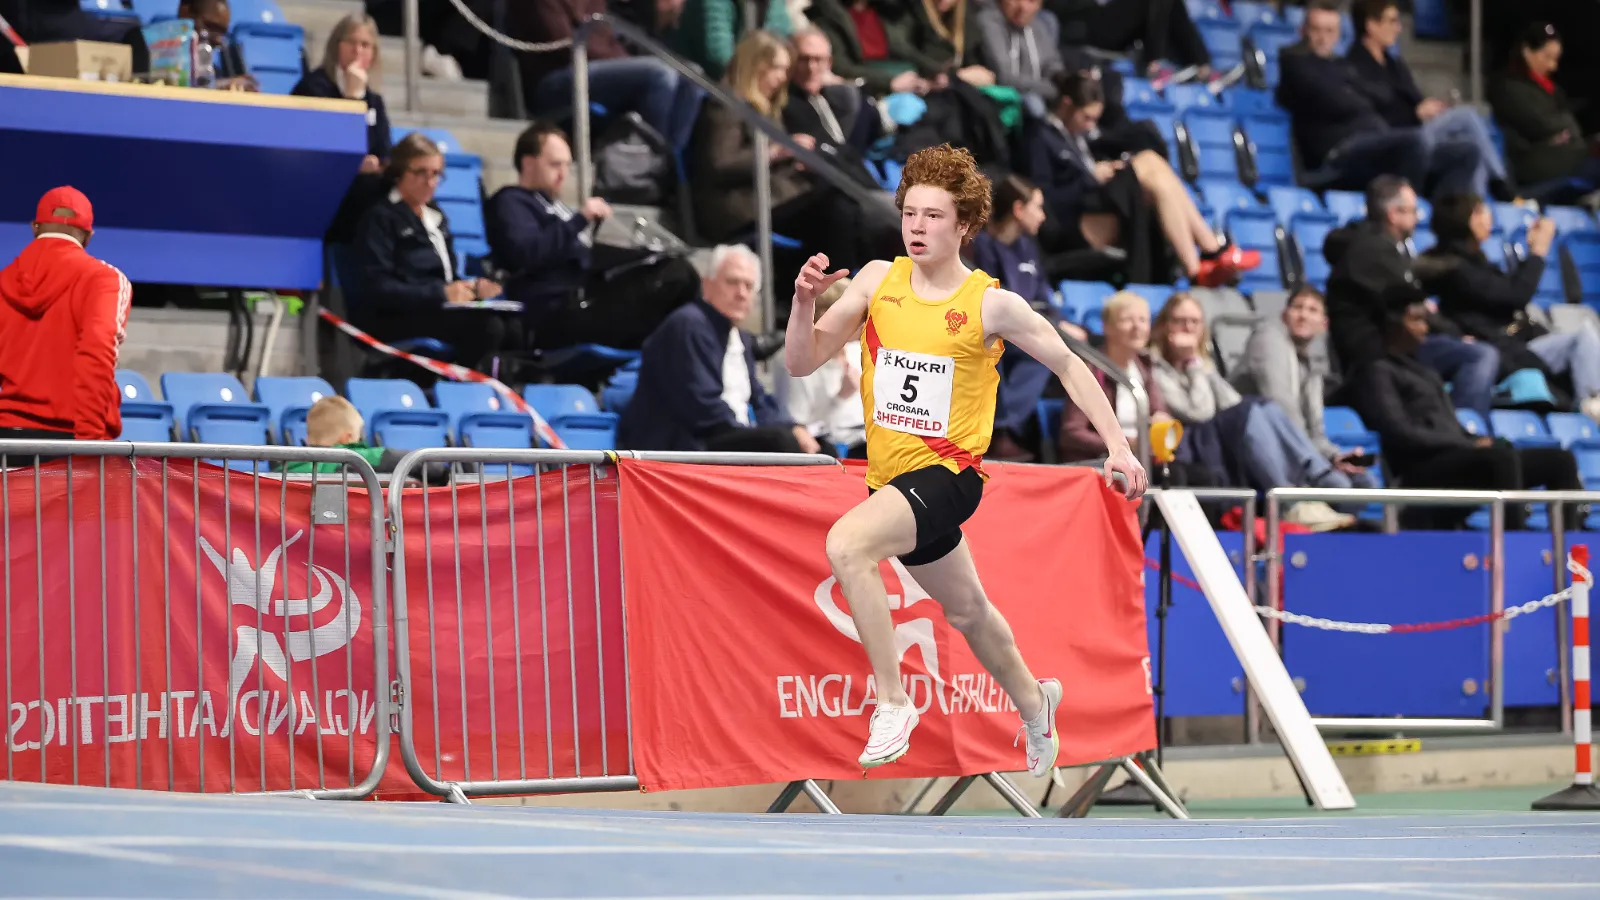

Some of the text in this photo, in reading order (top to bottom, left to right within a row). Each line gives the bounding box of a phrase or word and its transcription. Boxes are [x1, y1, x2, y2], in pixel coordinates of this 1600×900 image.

[894, 355, 946, 374] KUKRI
[900, 374, 920, 403] 5
[886, 402, 930, 416] CROSARA
[876, 410, 943, 432] SHEFFIELD
